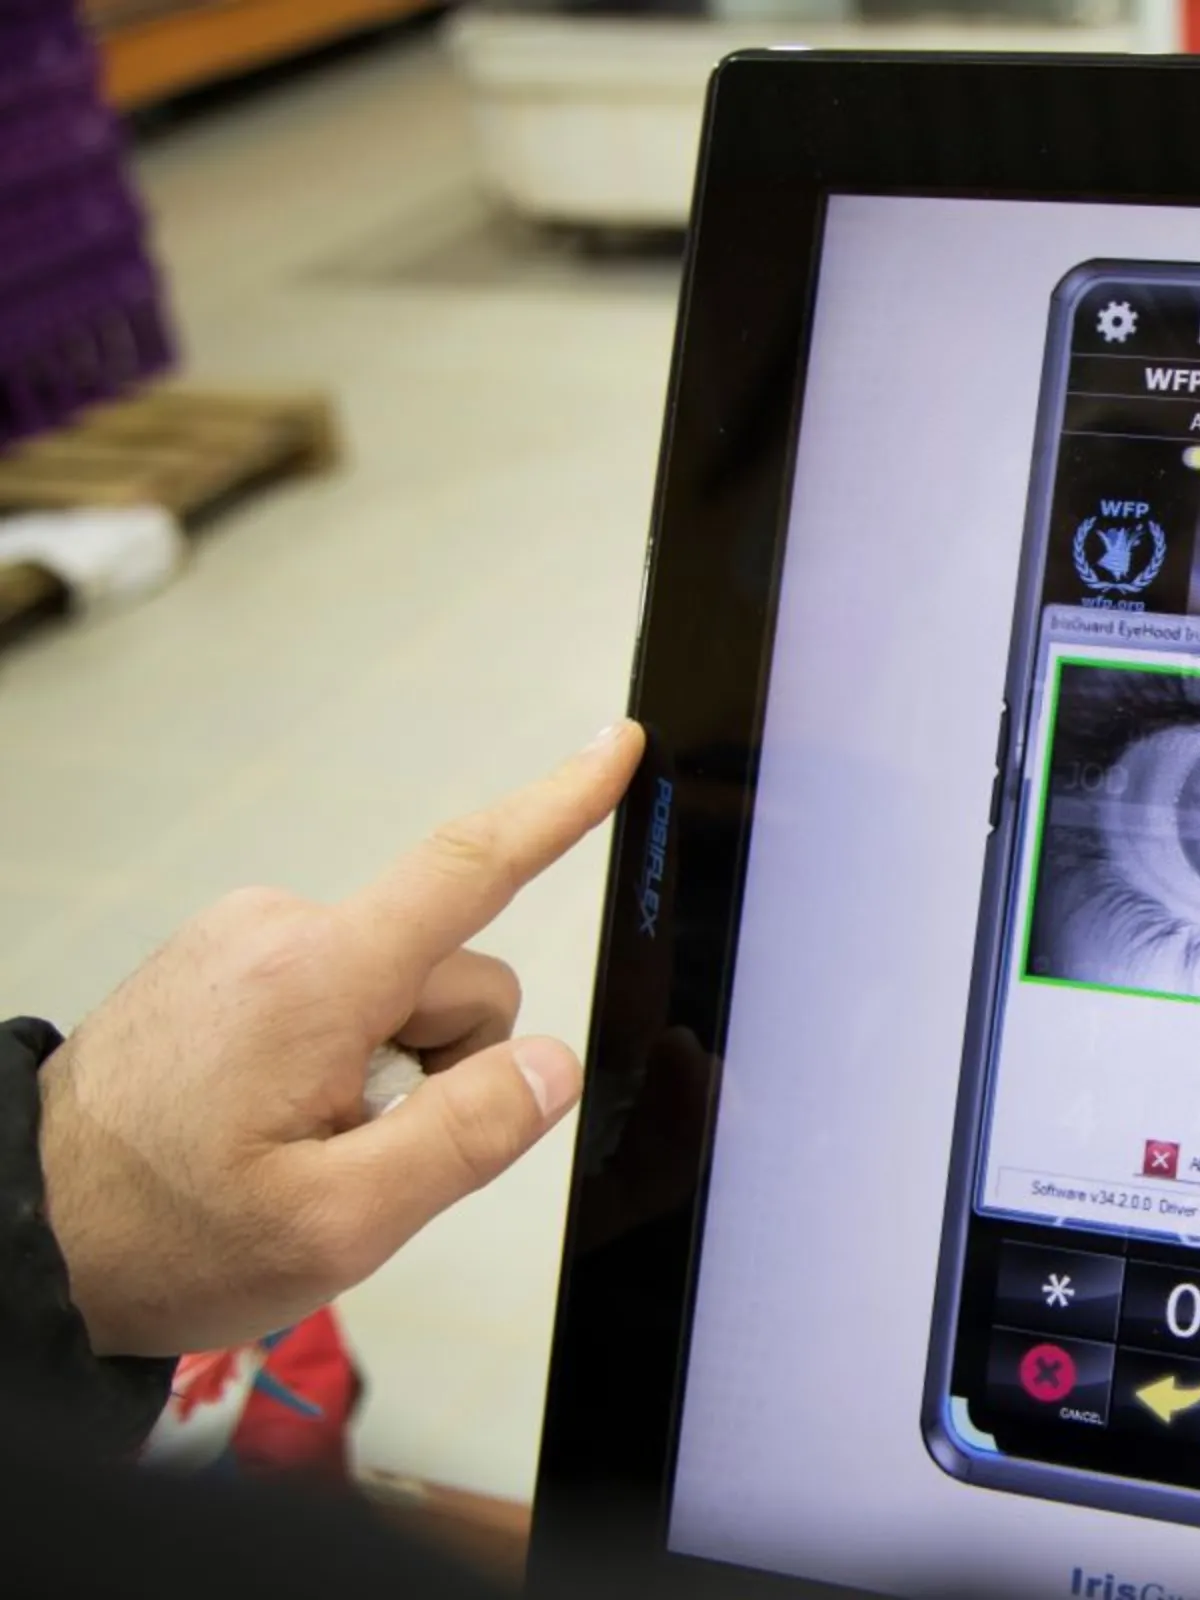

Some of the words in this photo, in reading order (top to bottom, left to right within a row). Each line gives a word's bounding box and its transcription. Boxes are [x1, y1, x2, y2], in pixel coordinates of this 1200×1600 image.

[1101, 499, 1149, 518] WFP
[1118, 621, 1181, 641] EyeHood
[639, 777, 672, 940] POSIFLEX
[1032, 1180, 1086, 1200] Software
[1159, 1200, 1197, 1217] Driver
[1060, 1407, 1104, 1425] CANCEL
